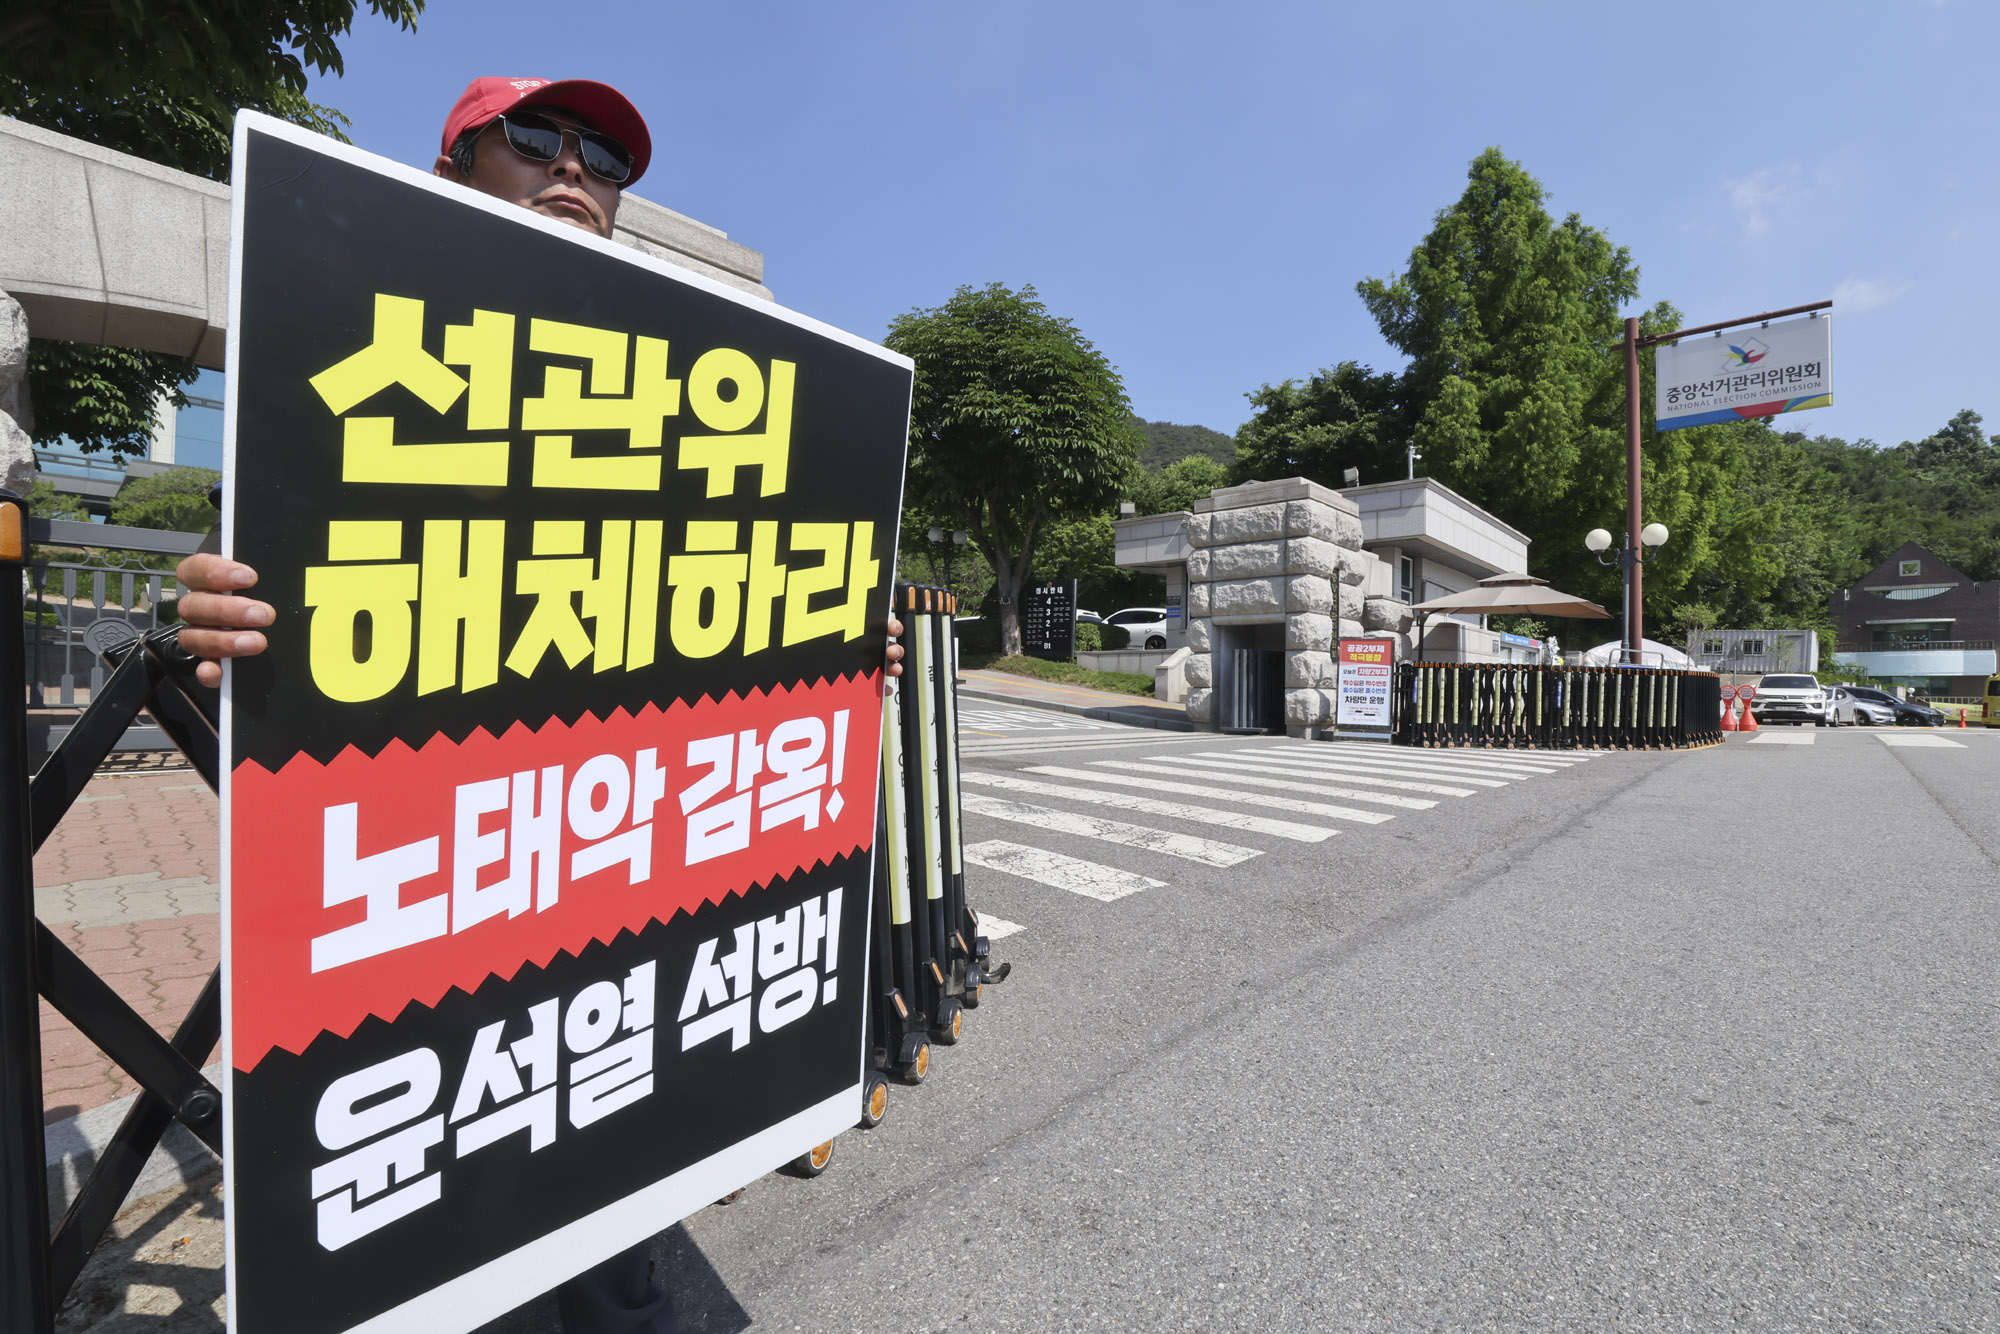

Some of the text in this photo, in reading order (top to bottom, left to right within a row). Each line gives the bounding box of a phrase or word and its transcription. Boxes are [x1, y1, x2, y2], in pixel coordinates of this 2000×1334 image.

[510, 80, 541, 90] STOP
[308, 293, 796, 498] 선관위
[1666, 361, 1821, 404] 중앙선거관리위원회
[1667, 381, 1821, 412] NATIONAL ELECTION COMMISSION
[305, 519, 879, 703] 해제하라
[1347, 644, 1385, 653] 공공2부제
[1344, 695, 1385, 704] 차량만 운행
[310, 747, 666, 974] 노태악
[679, 709, 850, 867] 감옥!
[310, 887, 843, 1252] 윤석열 석방!
